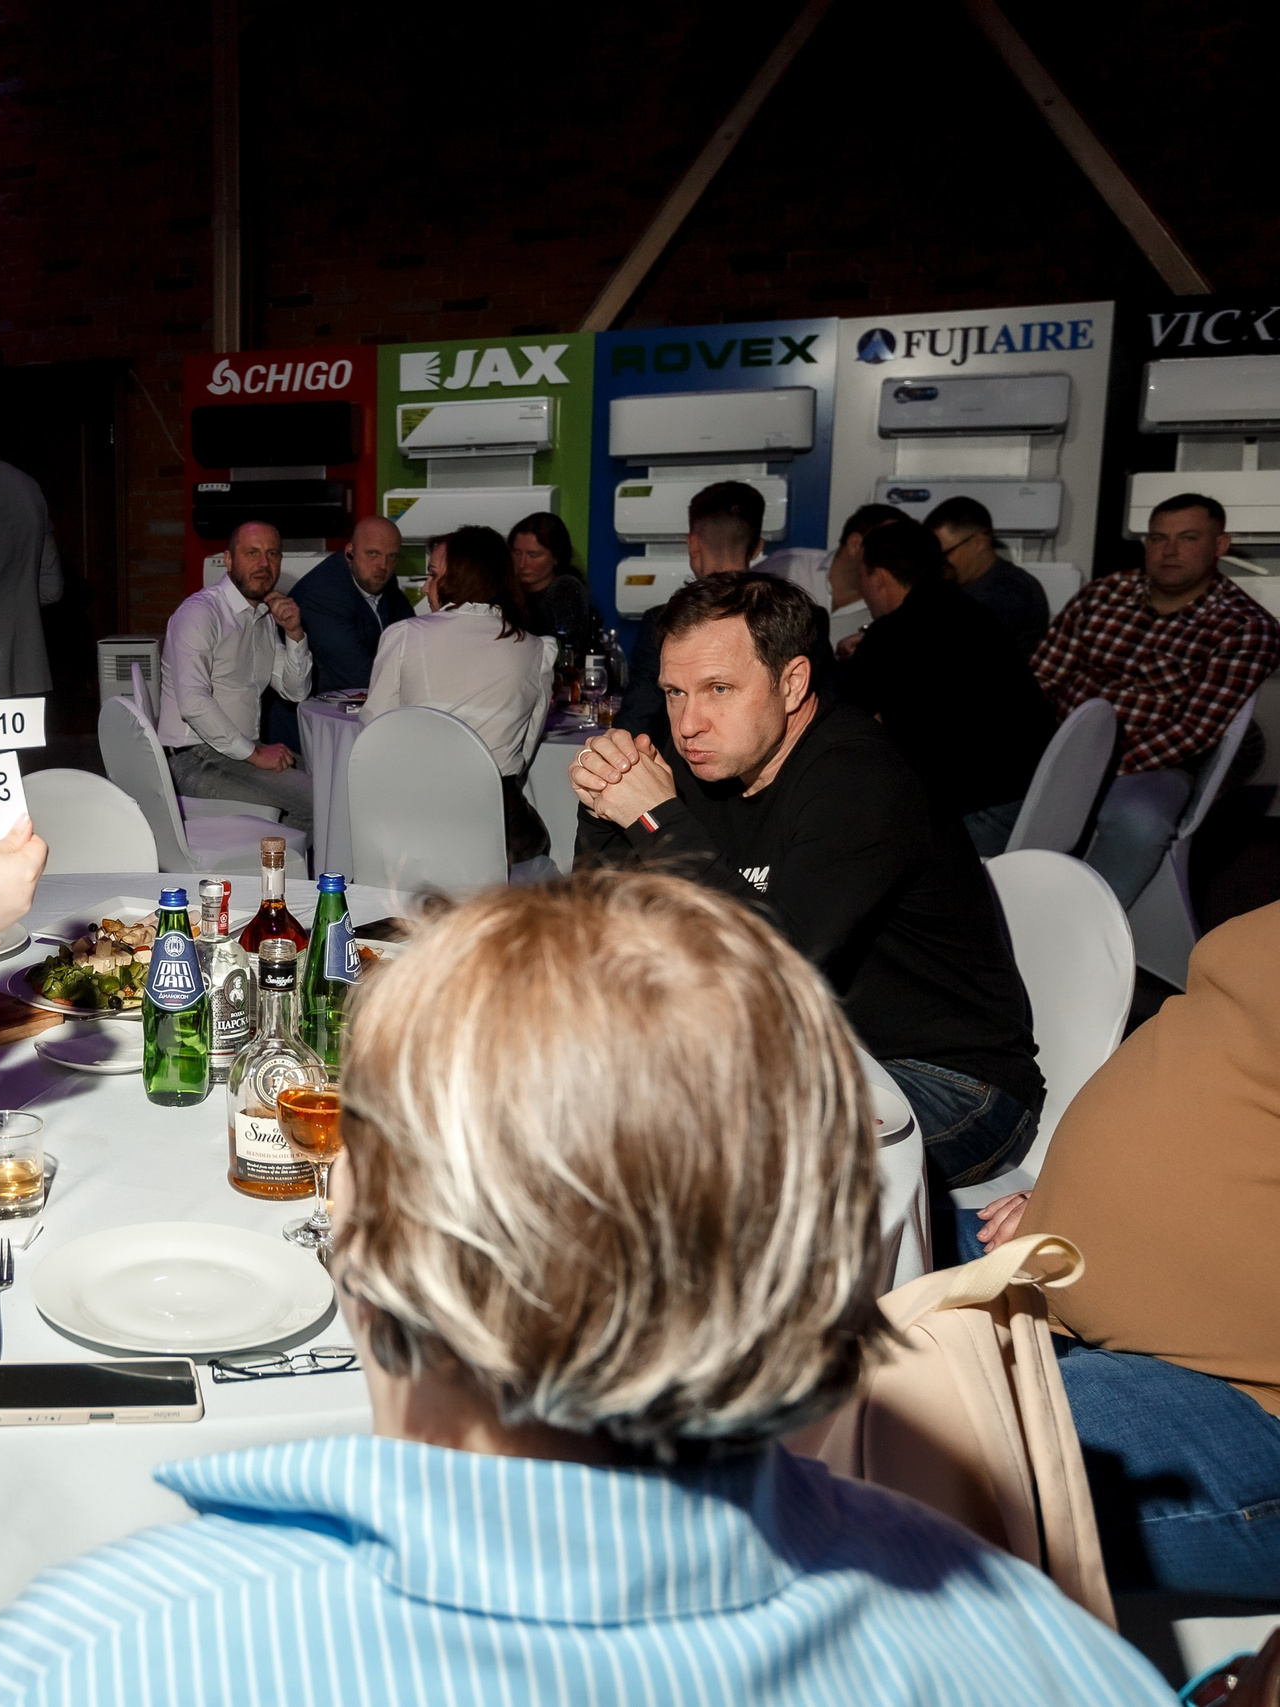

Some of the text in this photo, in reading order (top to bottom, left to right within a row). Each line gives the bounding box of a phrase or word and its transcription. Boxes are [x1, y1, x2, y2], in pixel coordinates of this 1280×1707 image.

[902, 319, 1094, 366] FUJIAIRE
[1146, 306, 1280, 348] VICK
[442, 344, 569, 390] JAX
[611, 335, 819, 376] ROVEX
[243, 359, 353, 394] CHIGO
[155, 974, 192, 988] JAN
[160, 963, 189, 976] DILI
